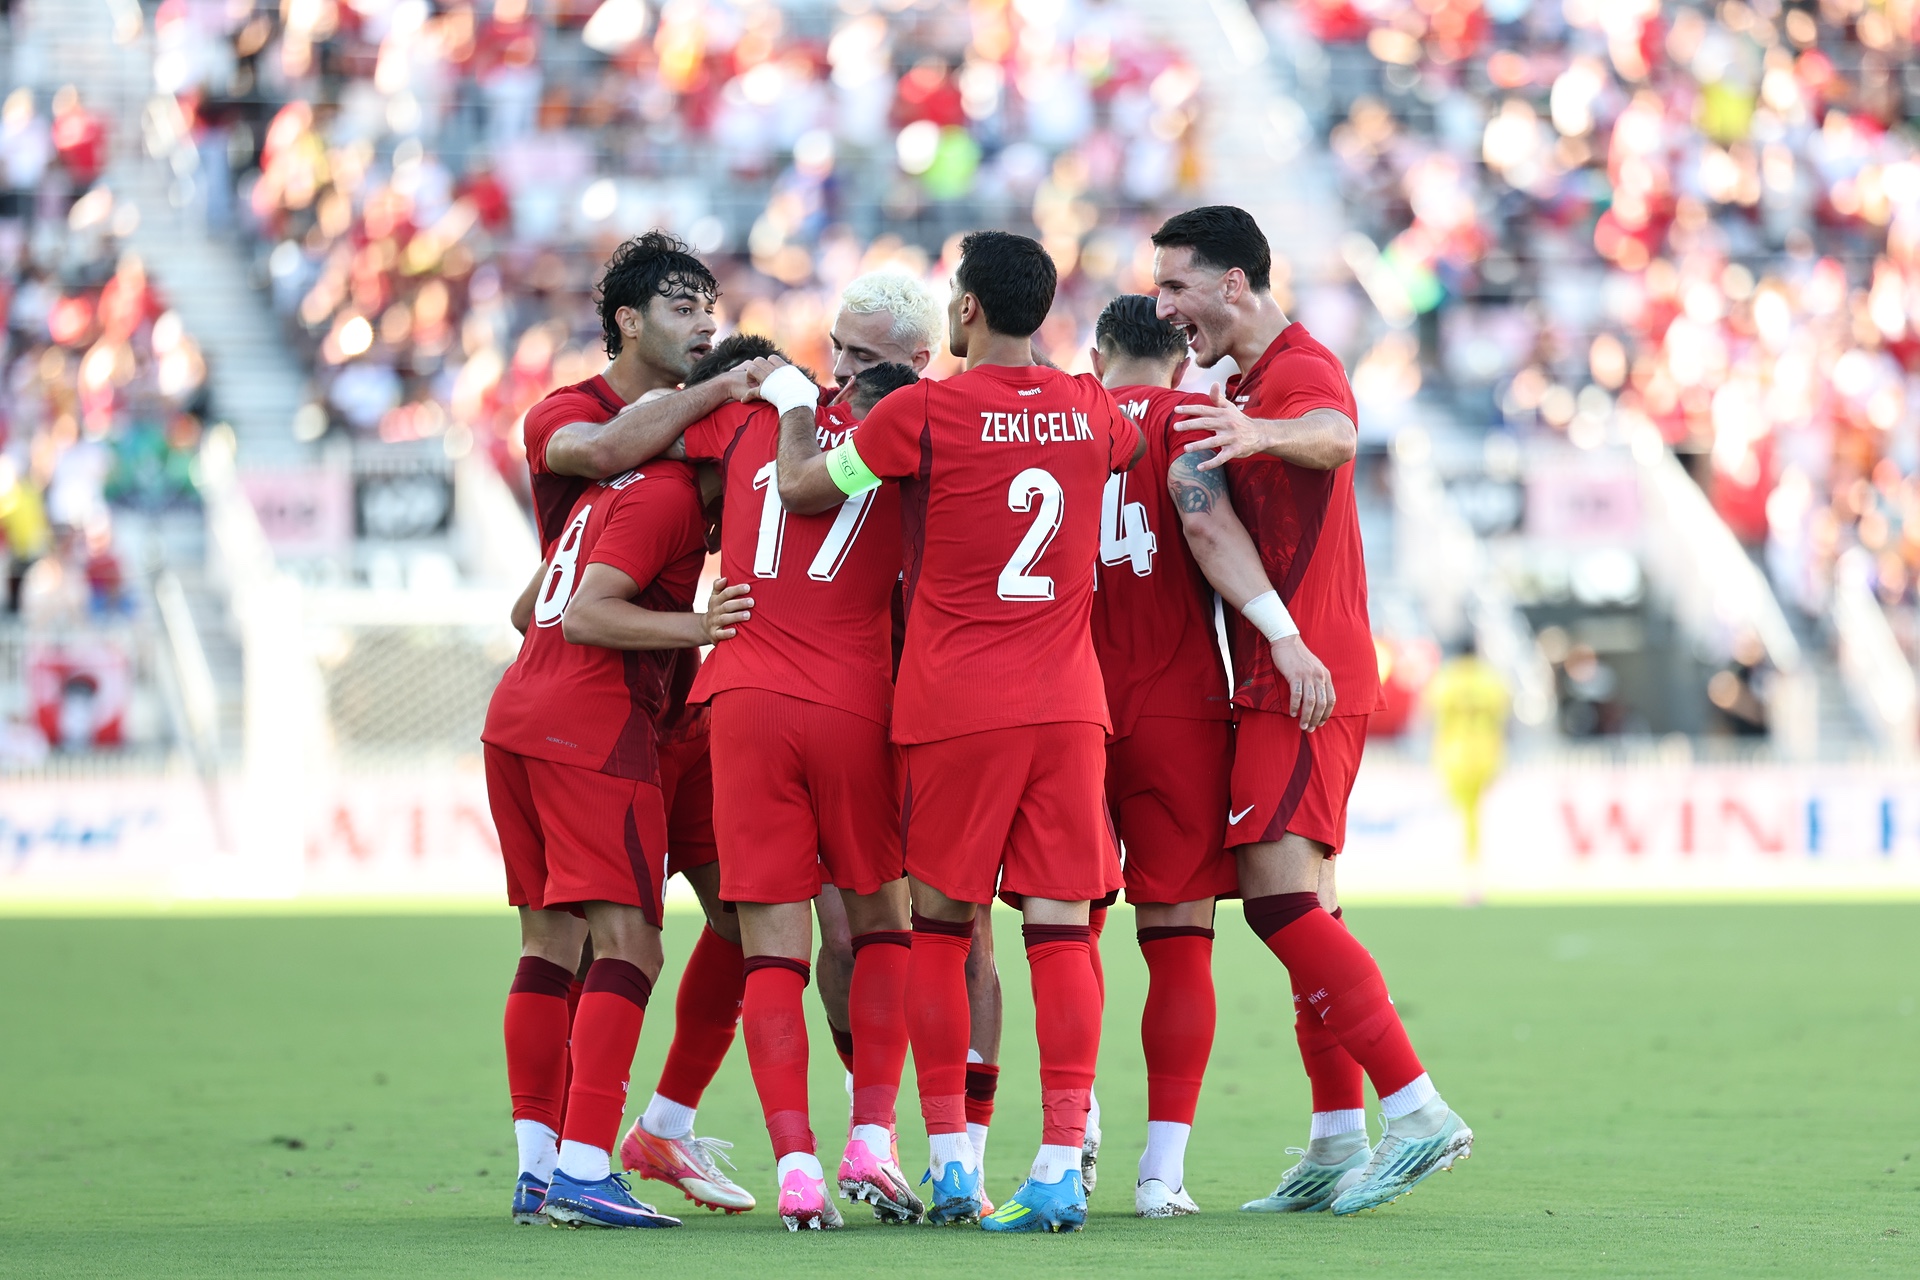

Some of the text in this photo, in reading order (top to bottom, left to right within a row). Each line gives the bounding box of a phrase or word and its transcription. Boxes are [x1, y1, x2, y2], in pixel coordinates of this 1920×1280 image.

[980, 406, 1094, 446] ZEKİ ÇELİK
[534, 504, 592, 628] 8
[997, 467, 1065, 602] 2
[1092, 471, 1158, 592] 4
